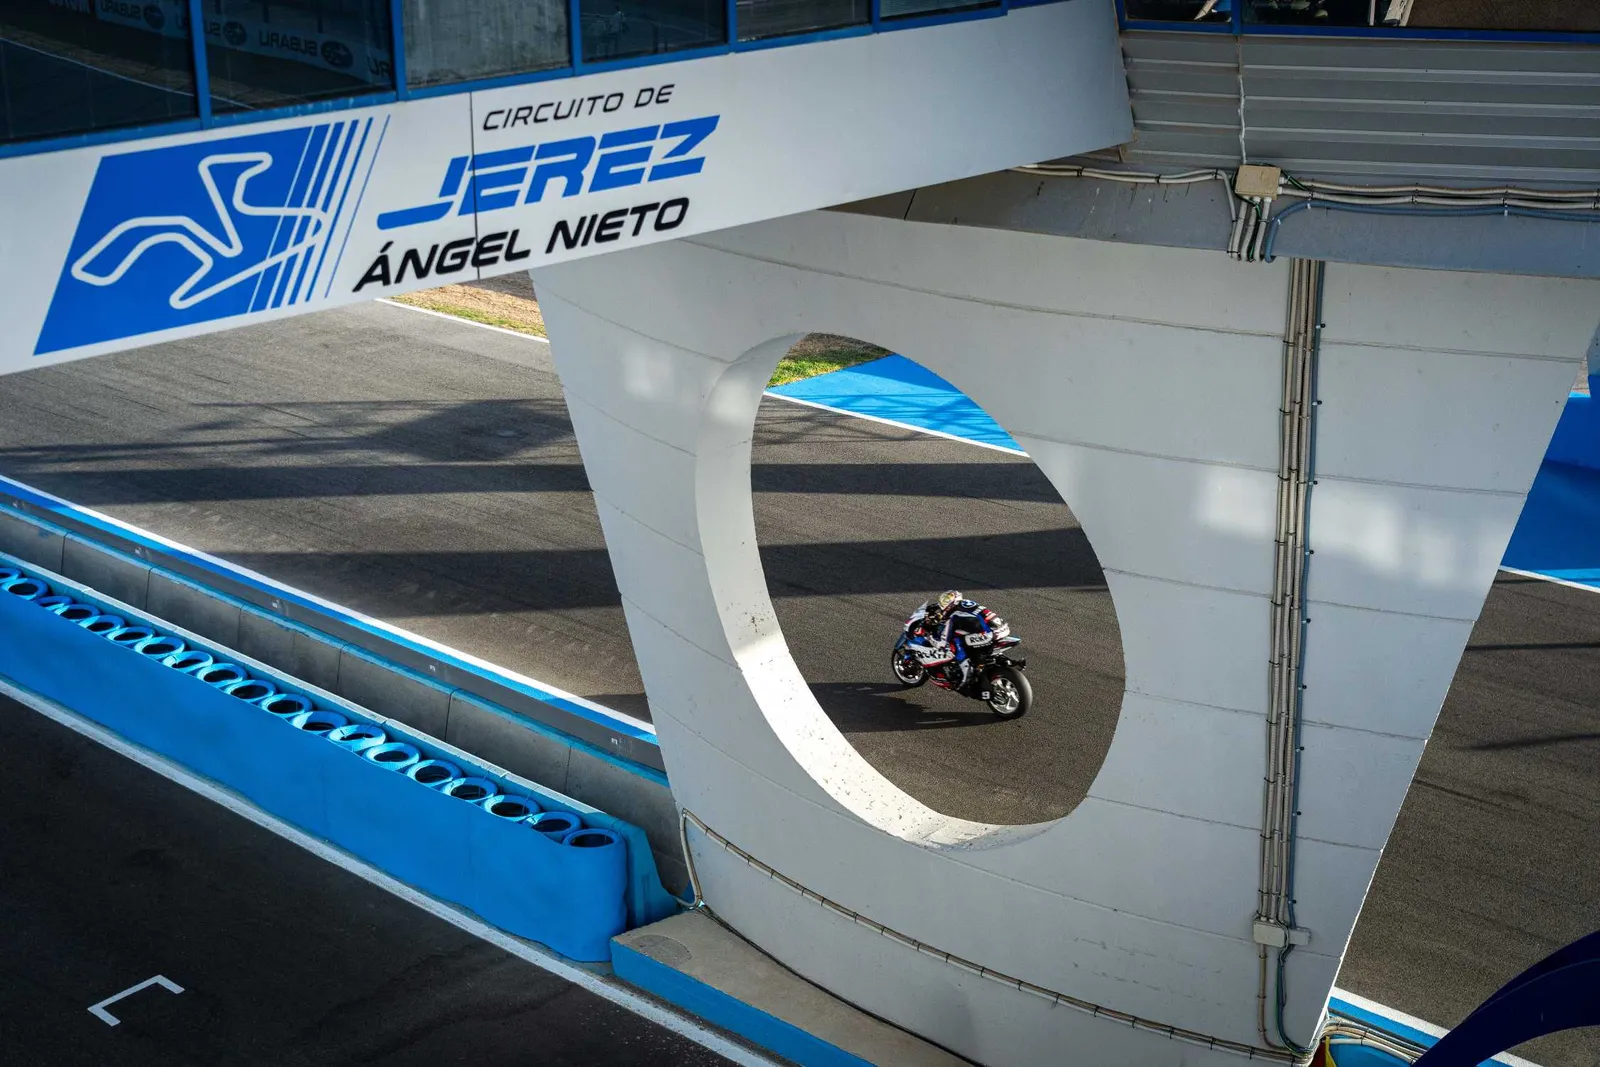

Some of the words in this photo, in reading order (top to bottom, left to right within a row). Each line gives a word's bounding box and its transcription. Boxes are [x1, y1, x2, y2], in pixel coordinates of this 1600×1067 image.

[482, 92, 624, 131] CIRCUITO
[634, 84, 675, 108] DE
[377, 114, 721, 231] JEREZ
[352, 229, 531, 293] ÁNGEL
[545, 197, 690, 254] NIETO
[981, 691, 990, 700] 9
